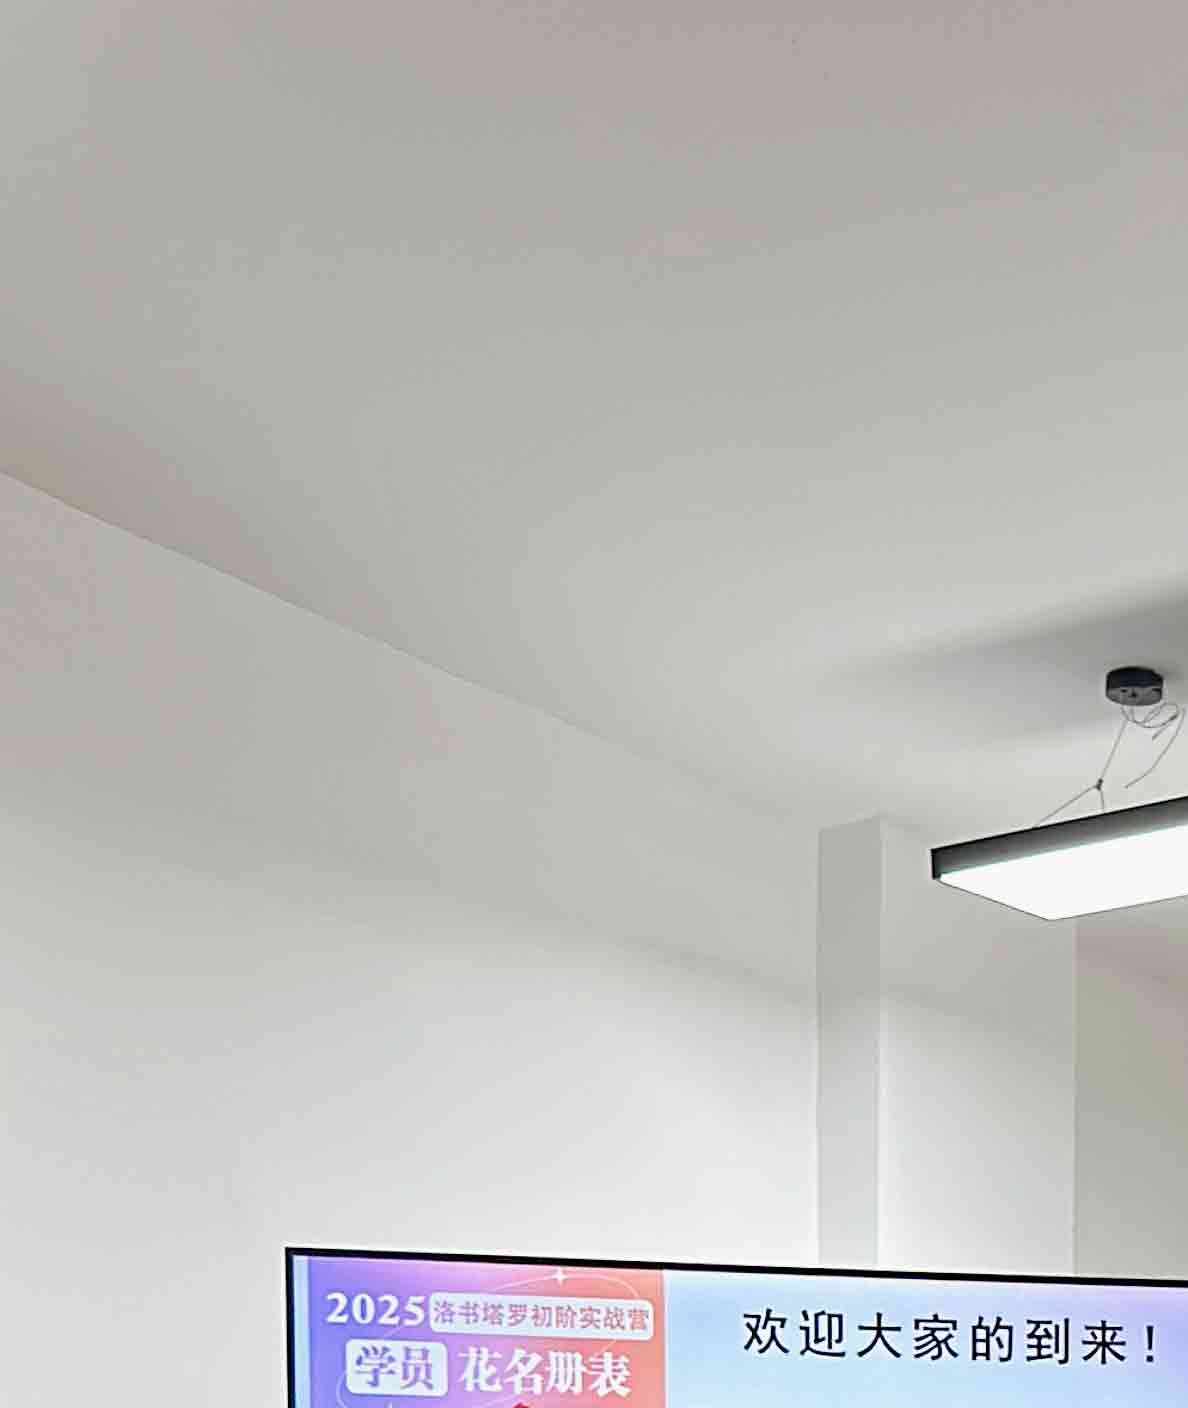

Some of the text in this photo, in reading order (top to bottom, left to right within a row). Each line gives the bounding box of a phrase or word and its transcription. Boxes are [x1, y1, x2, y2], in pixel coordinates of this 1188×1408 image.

[327, 1293, 650, 1331] 2025 洛书塔罗初阶实战营
[742, 1308, 1156, 1364] 欢迎大家的到来！
[355, 1346, 632, 1397] 学员 花名册表
